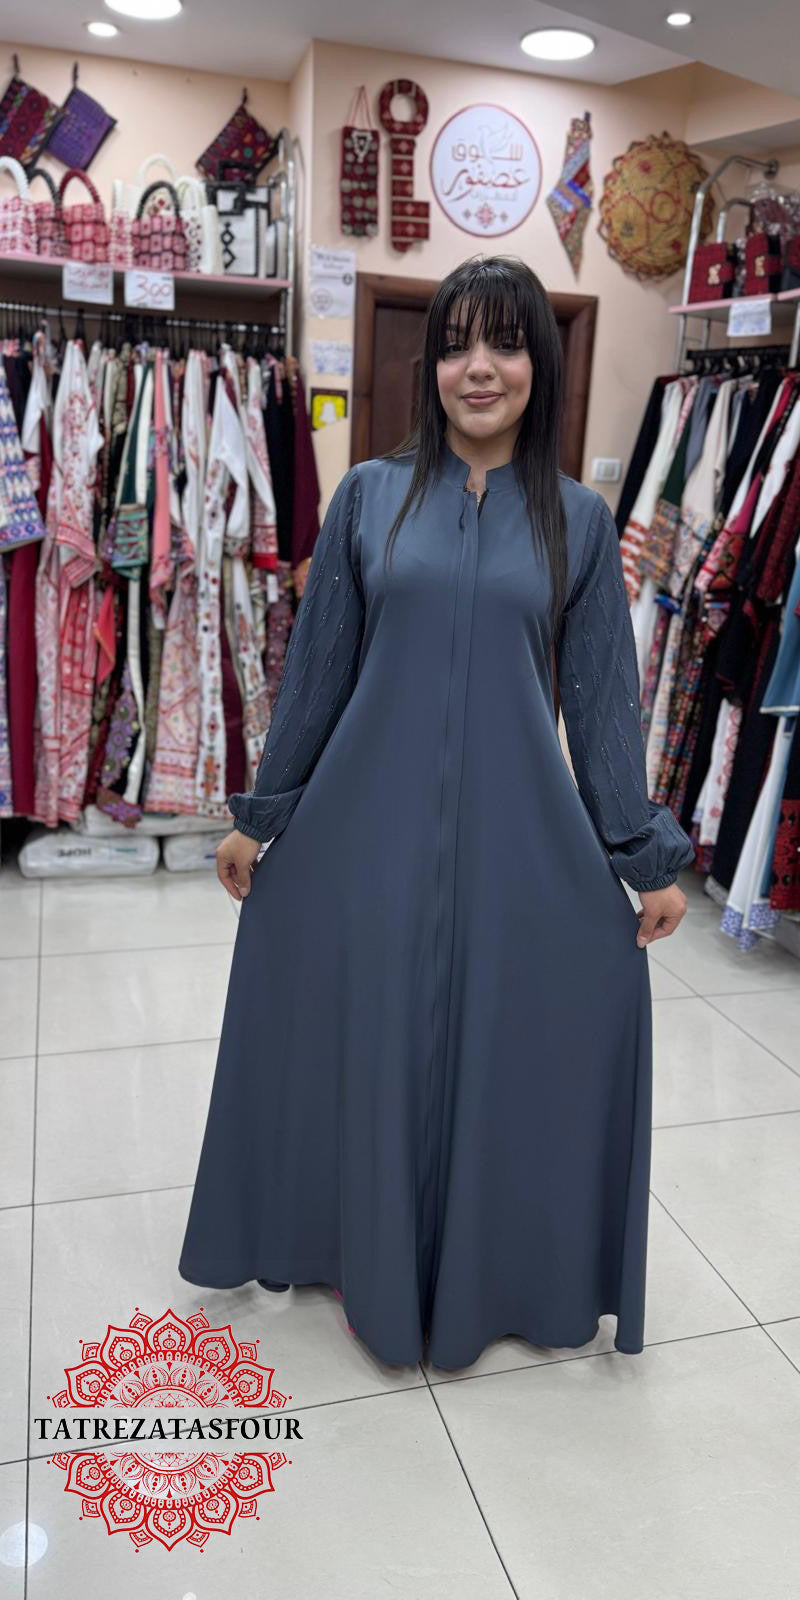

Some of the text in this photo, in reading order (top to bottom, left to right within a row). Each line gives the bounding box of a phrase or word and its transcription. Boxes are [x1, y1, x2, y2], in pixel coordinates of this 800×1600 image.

[451, 139, 524, 163] سوق
[441, 164, 531, 203] عصفور
[132, 274, 172, 302] 300
